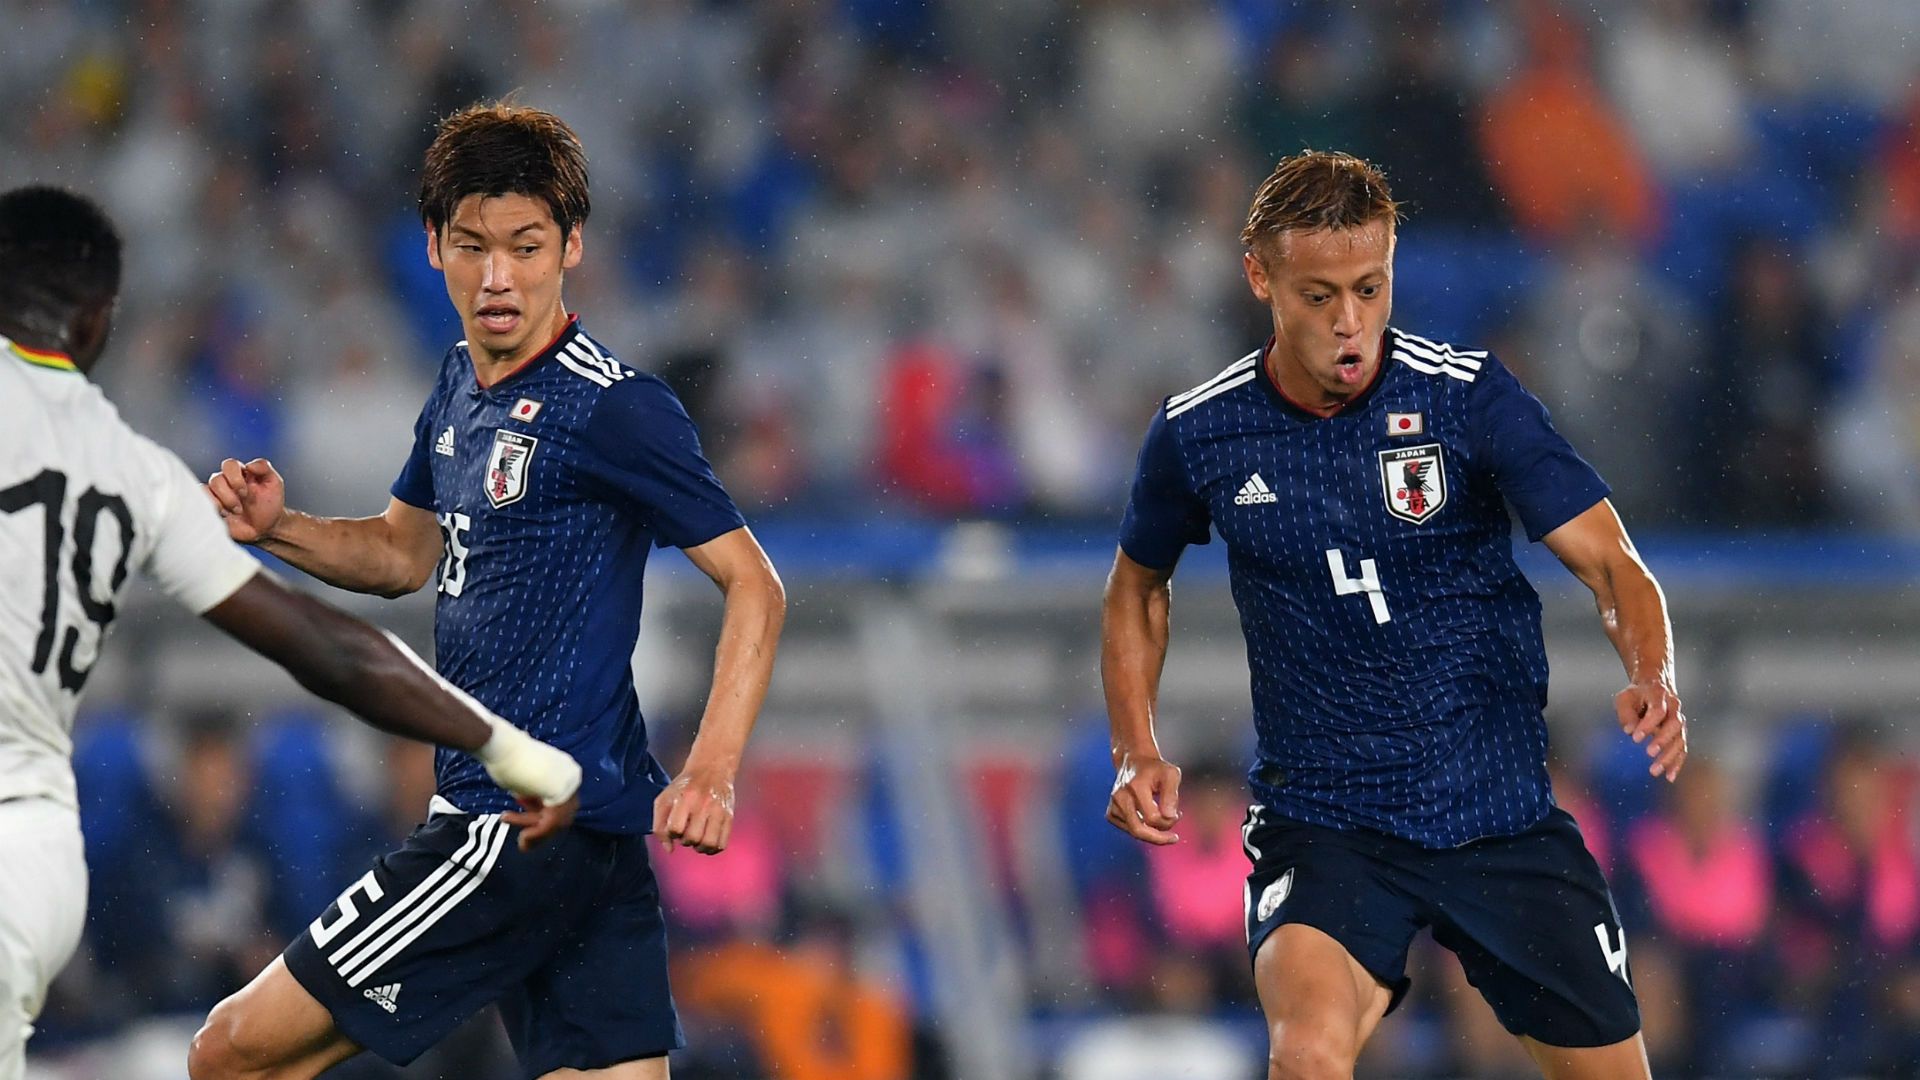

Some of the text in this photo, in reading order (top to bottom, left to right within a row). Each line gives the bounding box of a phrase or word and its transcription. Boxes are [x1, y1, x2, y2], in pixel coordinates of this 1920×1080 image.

[1395, 449, 1426, 459] JAPAN
[1234, 492, 1277, 505] adidas
[1405, 498, 1430, 512] JFA
[0, 468, 135, 695] 19
[1326, 548, 1391, 625] 4
[1594, 922, 1635, 994] 4
